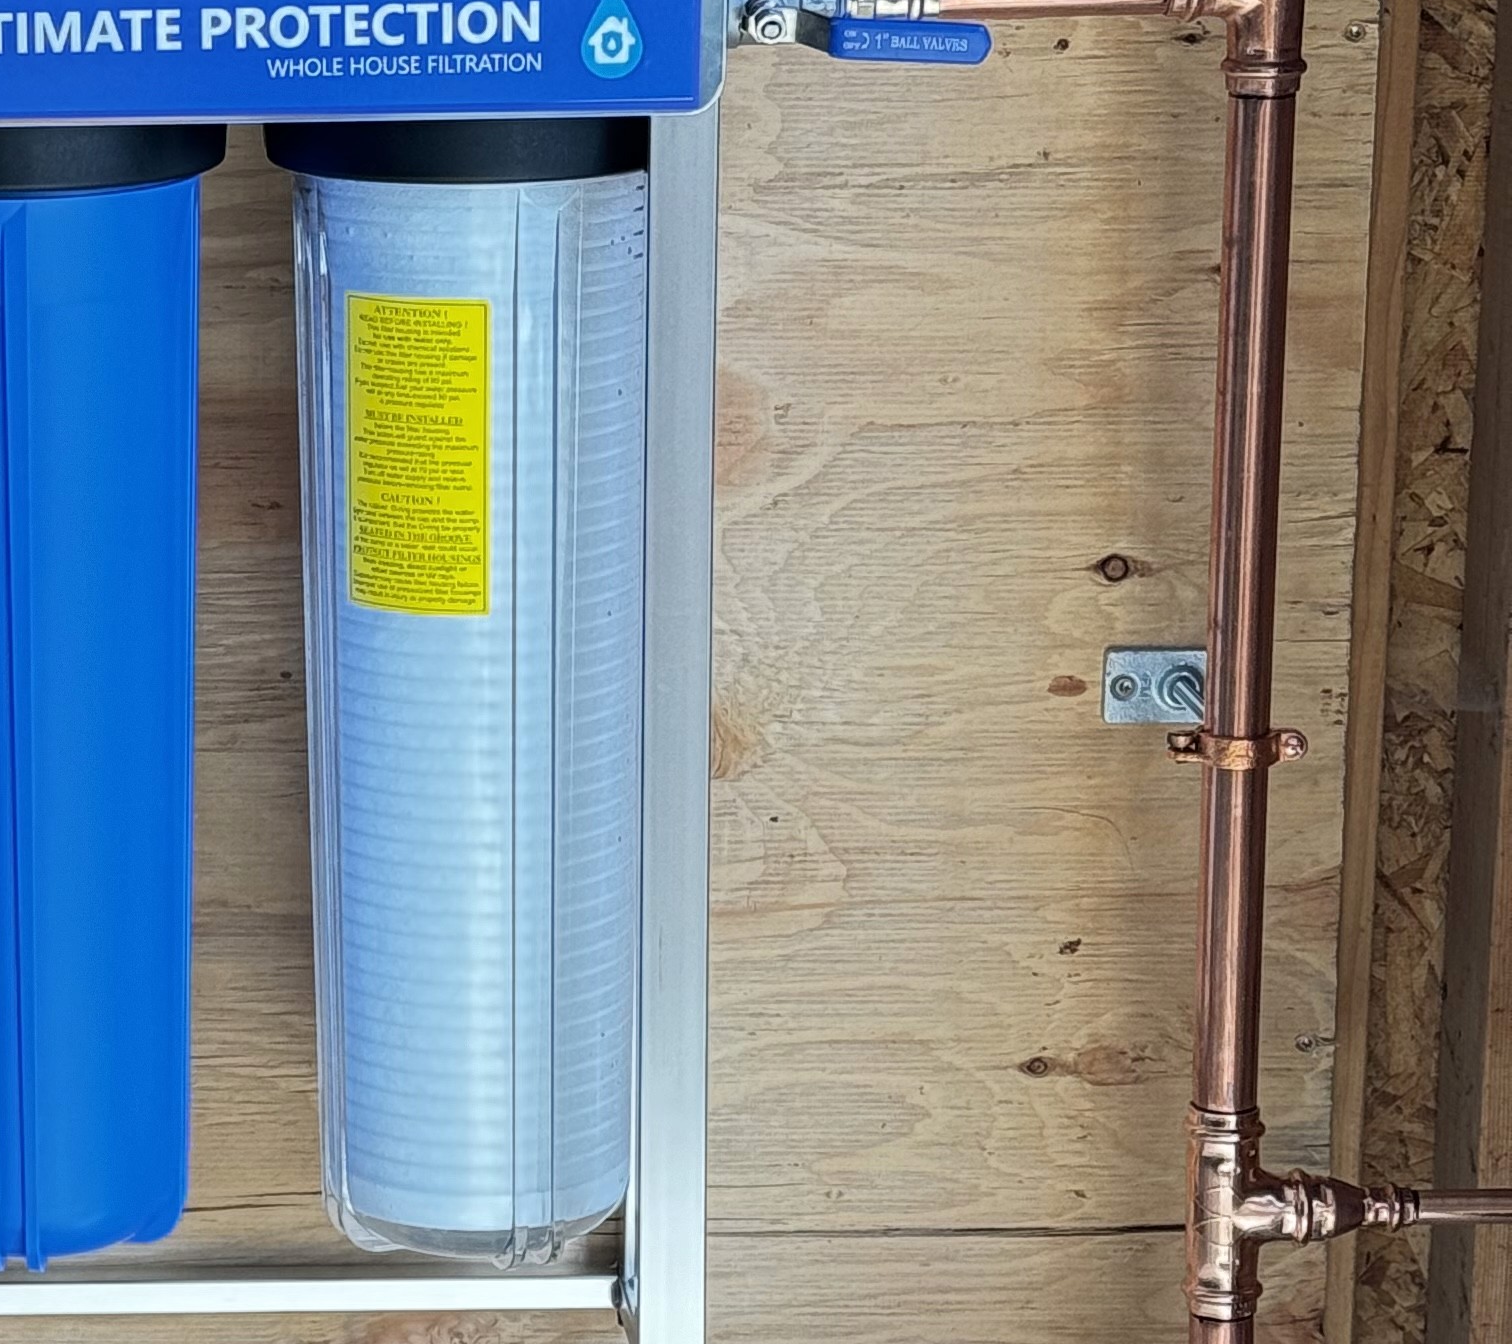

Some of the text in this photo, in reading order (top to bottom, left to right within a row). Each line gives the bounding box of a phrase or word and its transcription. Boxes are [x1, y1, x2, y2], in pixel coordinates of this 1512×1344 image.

[201, 0, 541, 50] PROTECTION
[890, 36, 920, 49] BALL
[922, 36, 968, 52] VALVES
[267, 52, 543, 78] WHOLE HOUSE FILTRATION
[380, 492, 434, 505] CAUTION
